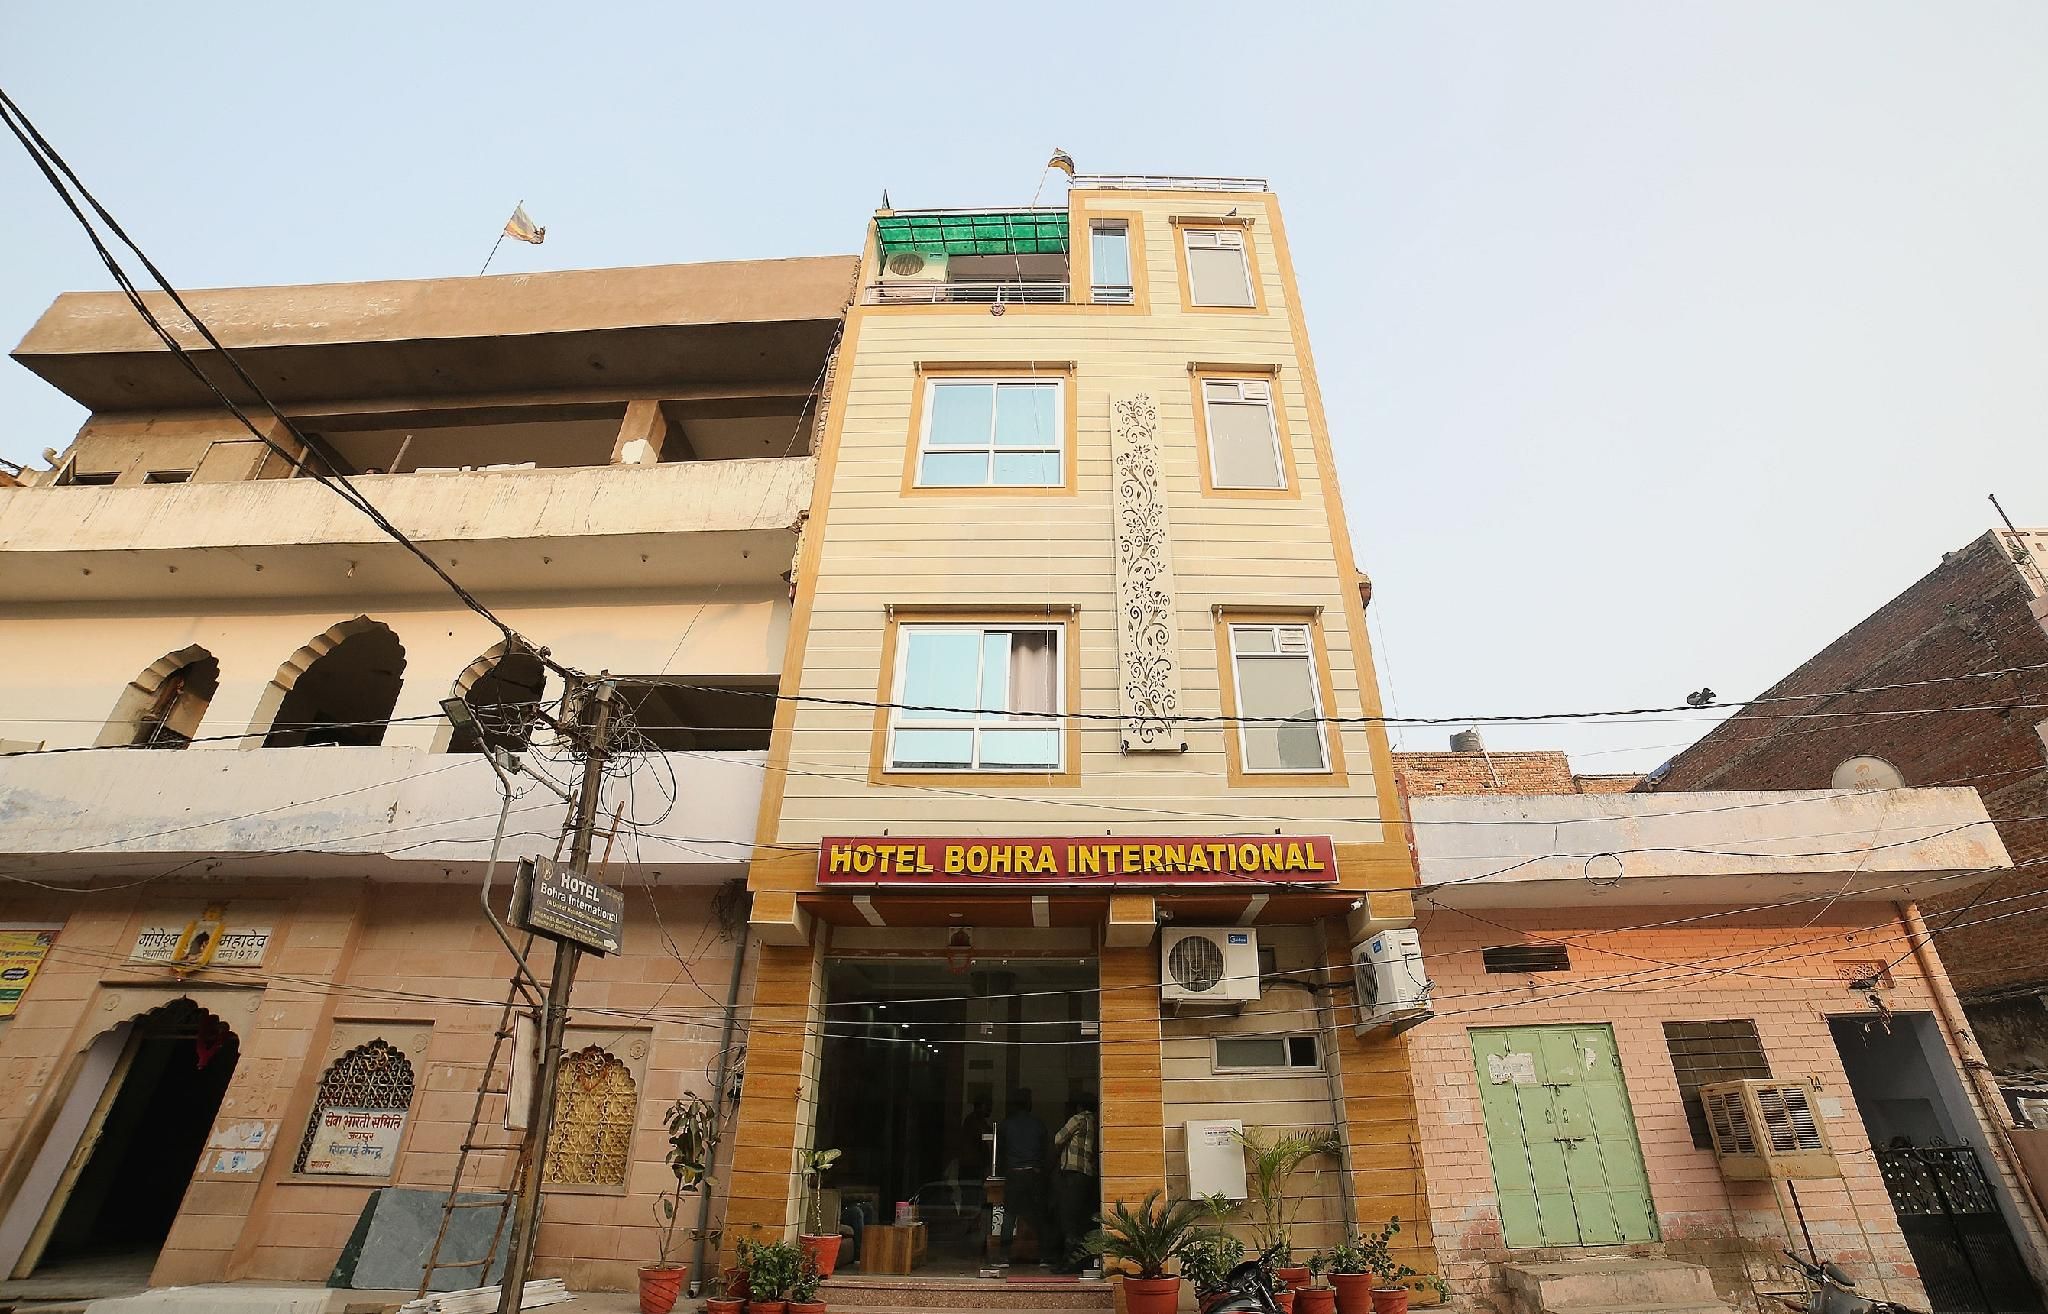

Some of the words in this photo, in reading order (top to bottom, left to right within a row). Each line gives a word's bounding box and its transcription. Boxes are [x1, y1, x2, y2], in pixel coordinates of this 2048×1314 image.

[829, 844, 934, 873] HOTEL
[944, 844, 1058, 873] BOHRA
[1067, 842, 1325, 873] INTERNATIONAL
[561, 872, 600, 903] HOTEL
[540, 882, 566, 903] Bohra
[568, 894, 618, 924] International
[138, 927, 182, 948] गोपेश्व
[219, 928, 269, 949] महादेव
[235, 949, 259, 960] 1977
[325, 1111, 342, 1128] सेवा
[343, 1111, 371, 1129] भारती
[371, 1114, 402, 1130] समिति
[348, 1131, 374, 1142] जयपुर
